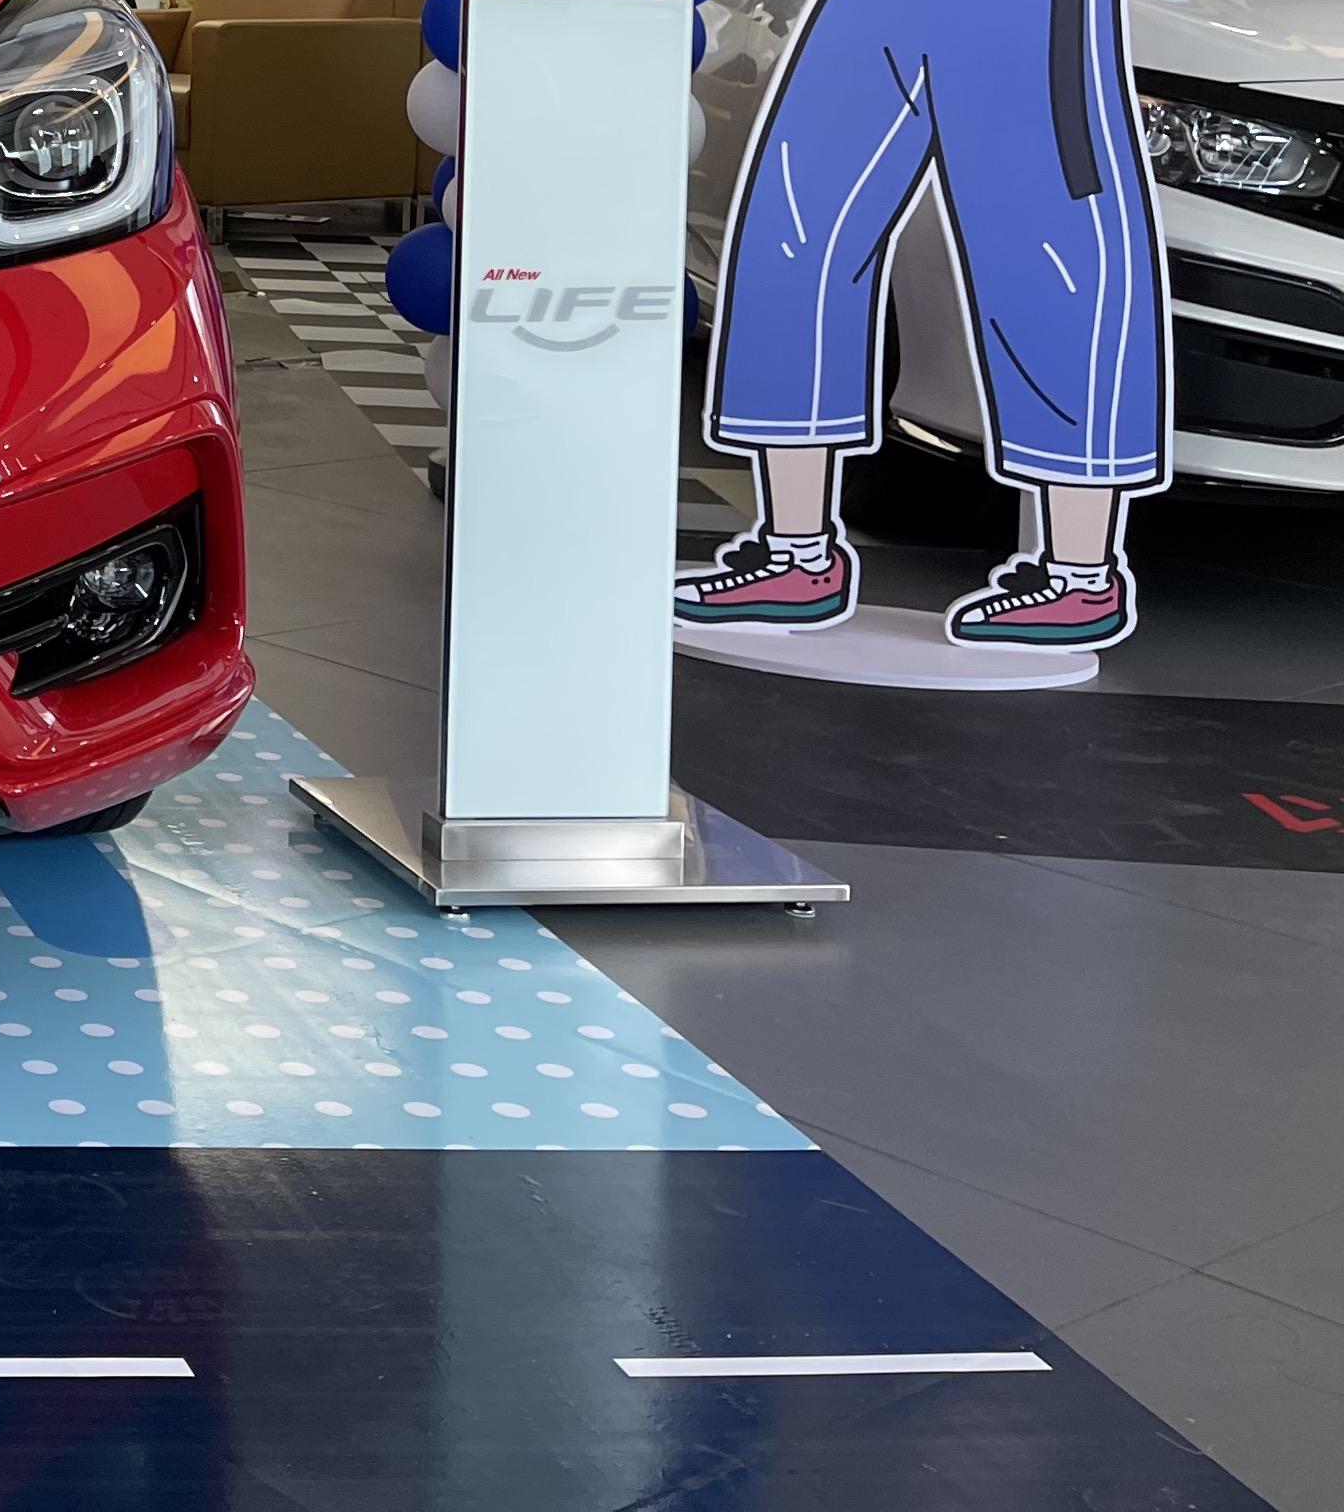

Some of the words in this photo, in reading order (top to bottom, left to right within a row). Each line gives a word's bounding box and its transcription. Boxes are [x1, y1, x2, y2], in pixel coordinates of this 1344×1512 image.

[482, 268, 504, 281] All
[506, 268, 542, 281] New
[470, 286, 677, 324] LIFE
